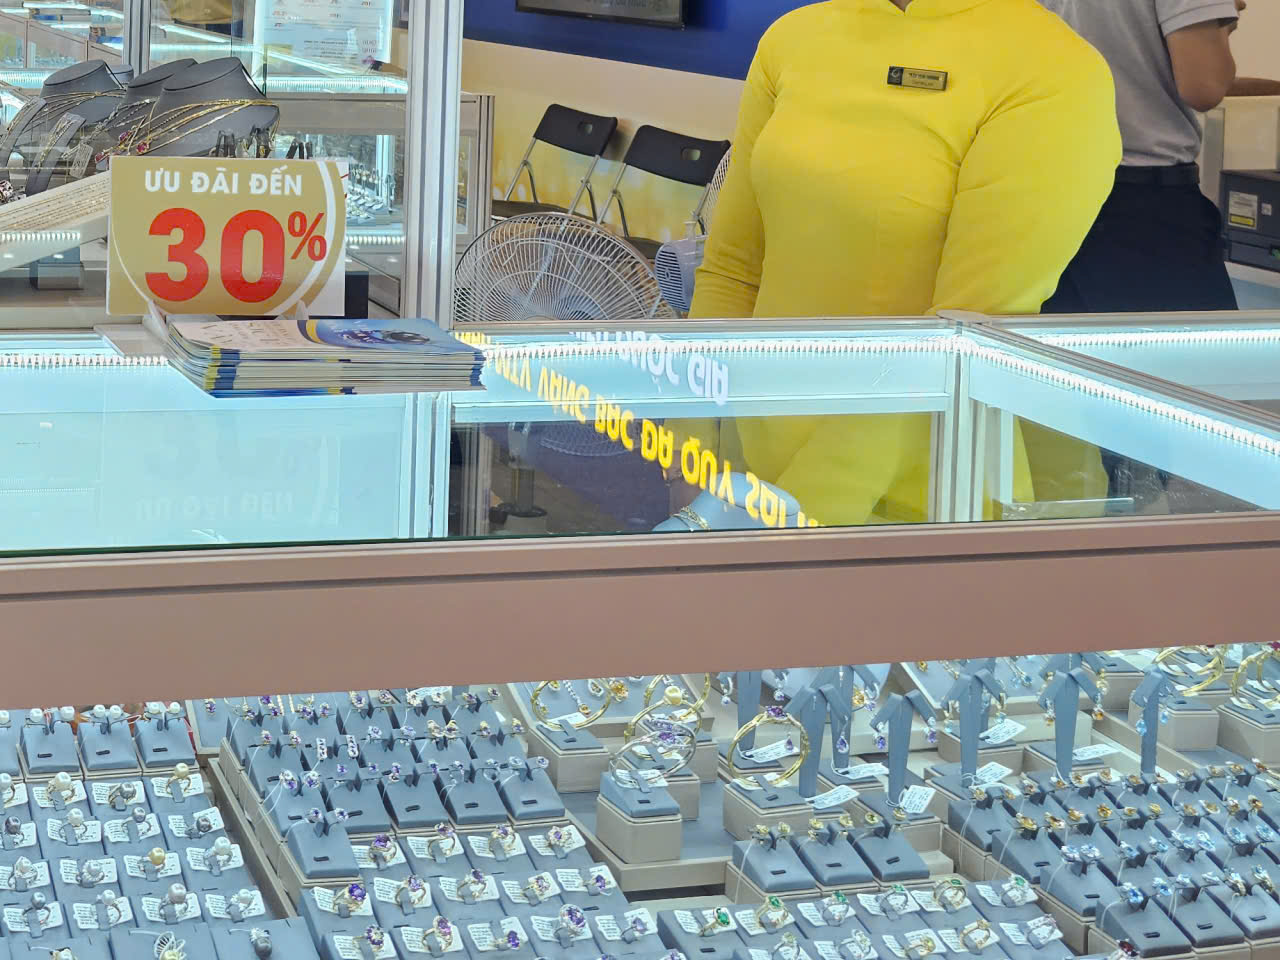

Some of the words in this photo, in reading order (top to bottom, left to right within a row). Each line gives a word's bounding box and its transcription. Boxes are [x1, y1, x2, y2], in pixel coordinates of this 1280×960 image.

[145, 167, 181, 192] ƯU
[190, 167, 239, 194] ĐÃI
[249, 165, 303, 196] ĐẾN
[145, 207, 328, 304] 30%
